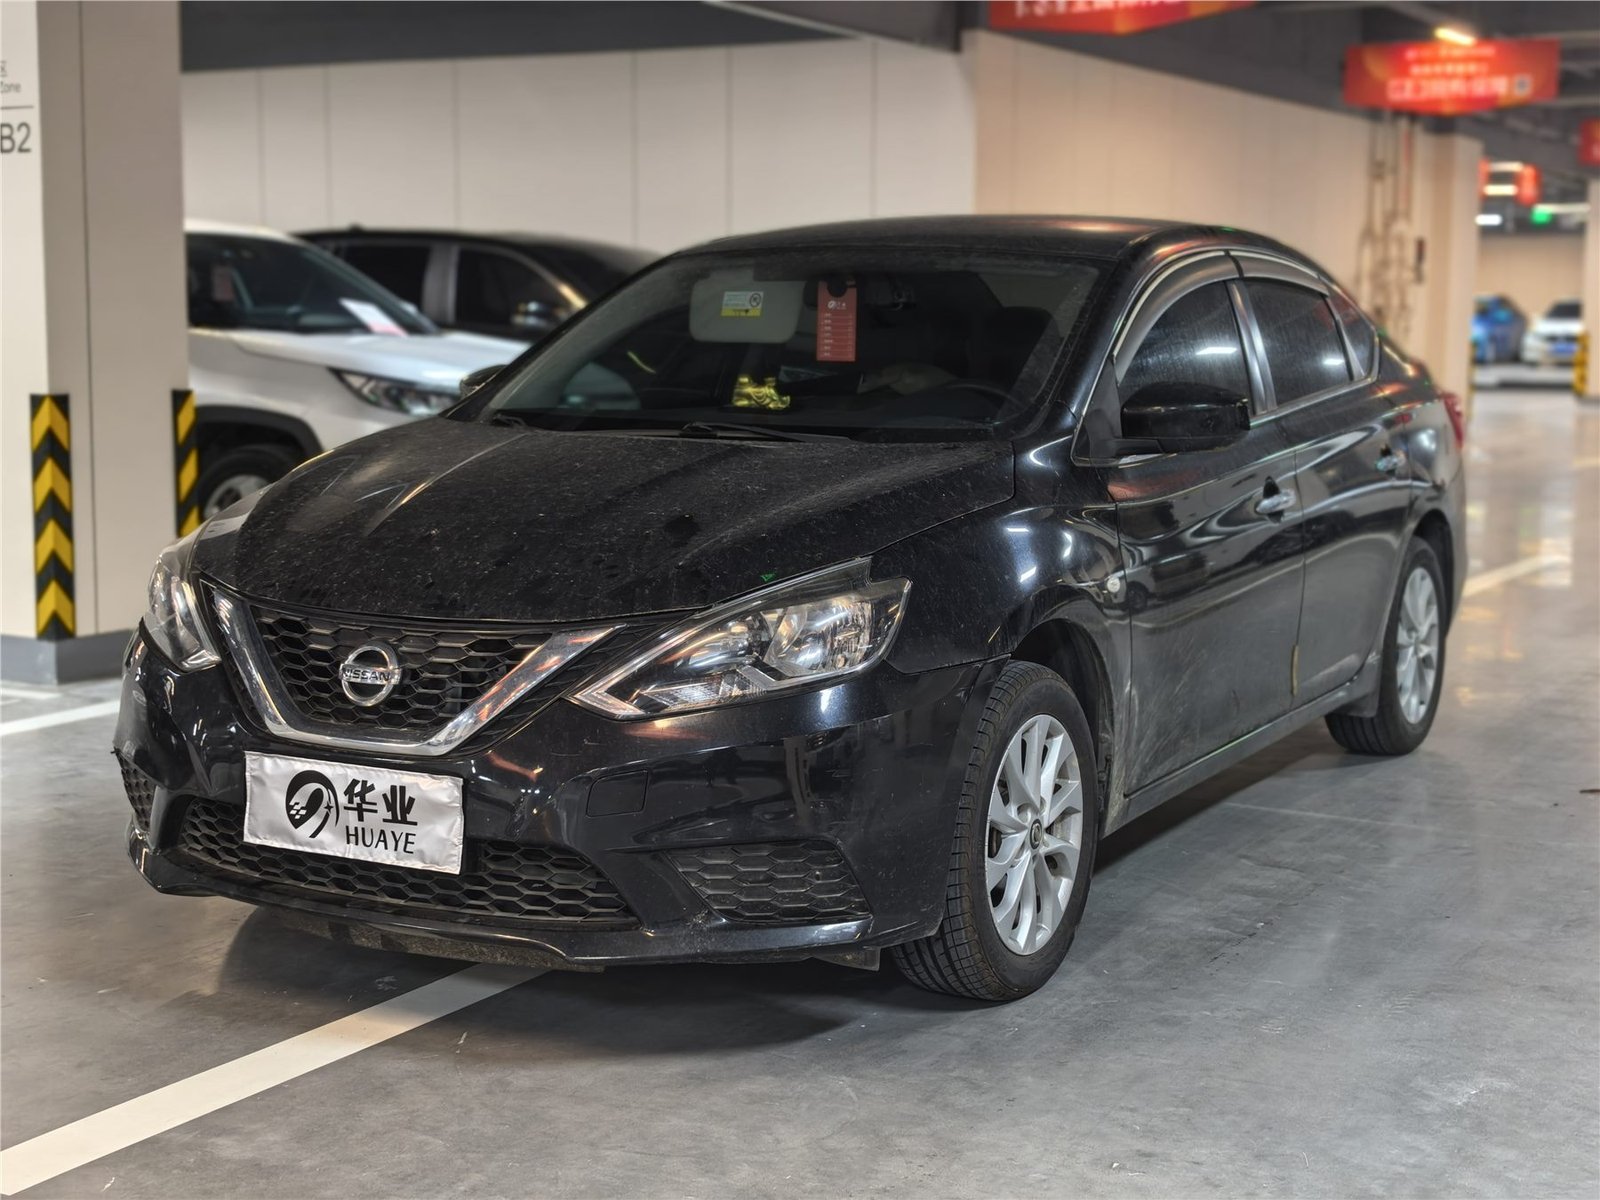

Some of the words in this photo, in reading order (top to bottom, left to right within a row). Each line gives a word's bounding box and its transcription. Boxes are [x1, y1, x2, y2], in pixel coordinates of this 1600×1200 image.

[0, 122, 31, 153] B2
[341, 667, 391, 682] NISSAN
[343, 778, 418, 826] 华业
[345, 826, 416, 854] HUAYE
